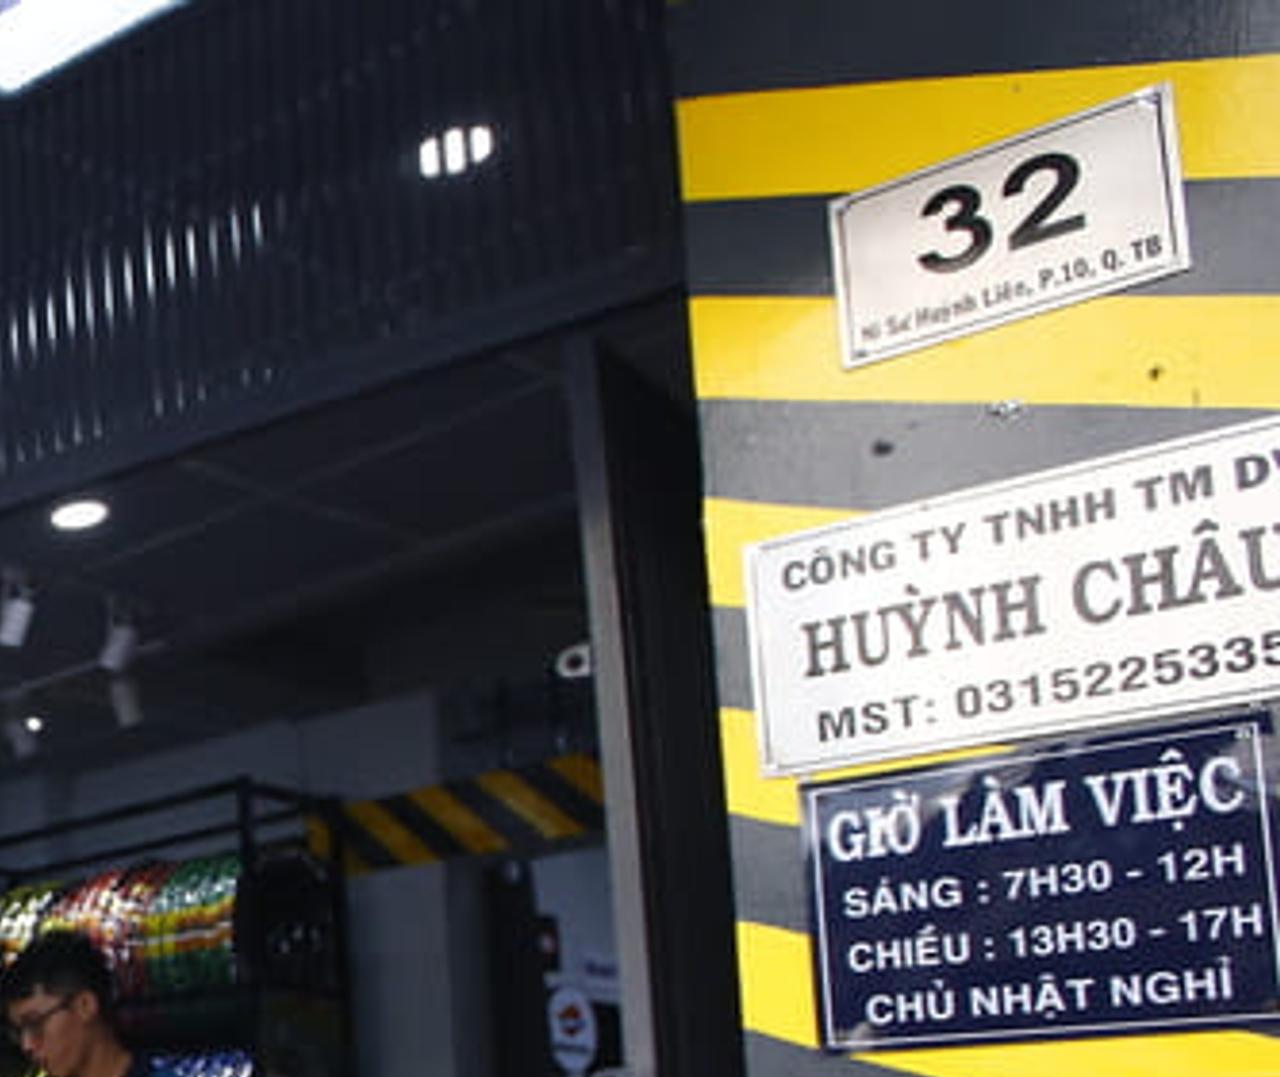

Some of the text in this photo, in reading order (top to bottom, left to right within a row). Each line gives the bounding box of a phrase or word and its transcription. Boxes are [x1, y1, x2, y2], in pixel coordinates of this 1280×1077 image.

[917, 151, 1088, 275] 32
[1039, 257, 1097, 290] P.10,
[1101, 249, 1126, 273] Q.
[1130, 234, 1164, 262] TB
[781, 541, 896, 592] CÔNG
[911, 521, 967, 562] TY
[984, 488, 1117, 545] TNHH
[1133, 463, 1215, 511] TM
[801, 517, 1280, 679] HUỲNH CHÂU
[817, 629, 1280, 742] MST: 0315225335
[827, 748, 1246, 862] GIỜ LÀM VIỆC
[843, 876, 964, 919] SÁNG
[1002, 858, 1114, 901] 7H30
[1157, 843, 1247, 883] 12H
[1008, 916, 1137, 958] 13H30
[1178, 903, 1264, 943] 17H
[865, 955, 1235, 1026] CHỦ NHẬT NGHỈ
